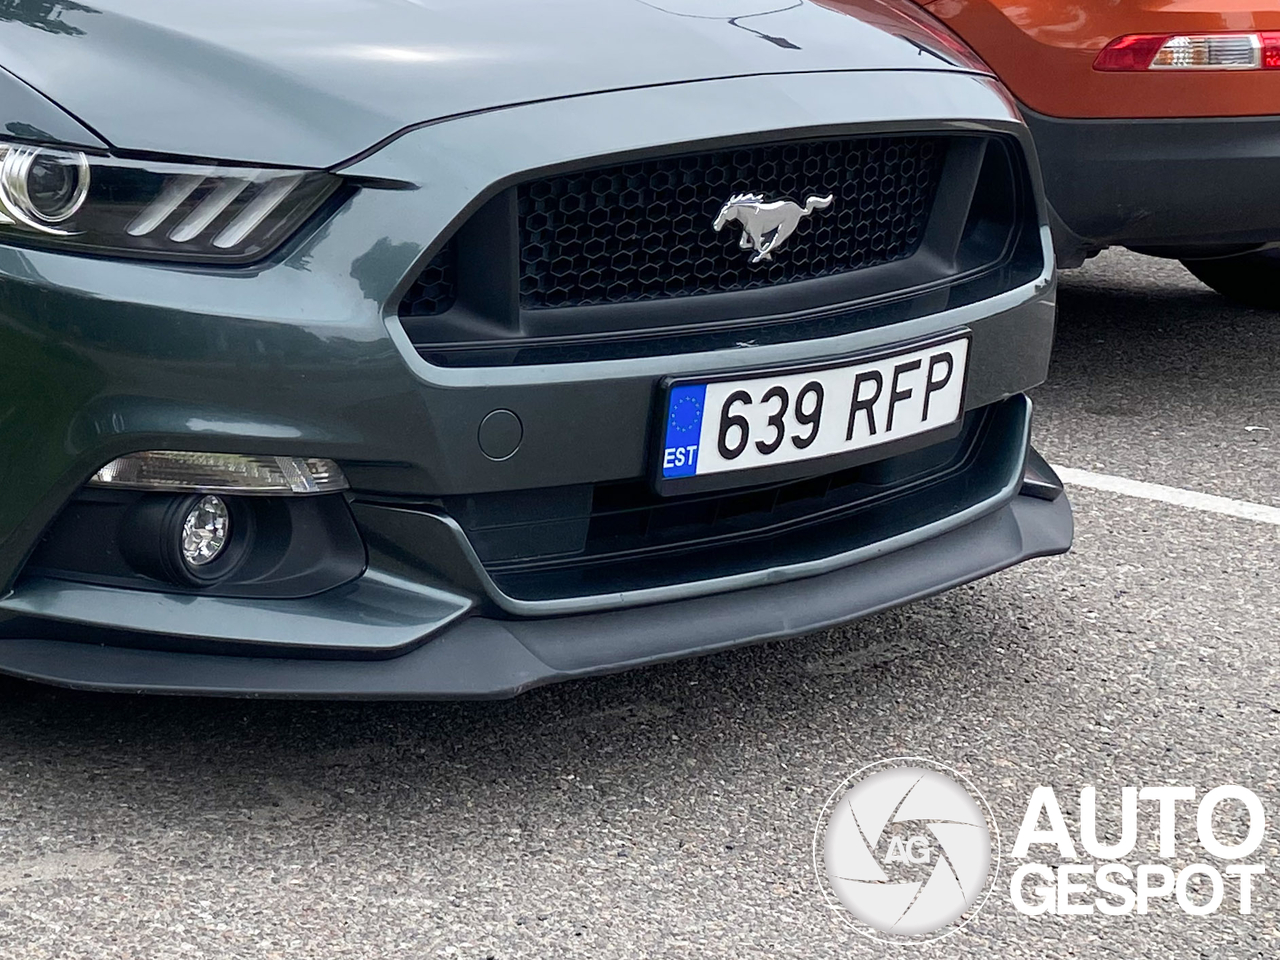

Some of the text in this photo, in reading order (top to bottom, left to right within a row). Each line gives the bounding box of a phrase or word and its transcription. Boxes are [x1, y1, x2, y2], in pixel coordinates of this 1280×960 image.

[718, 351, 954, 460] 639 RFP
[663, 445, 697, 468] EST
